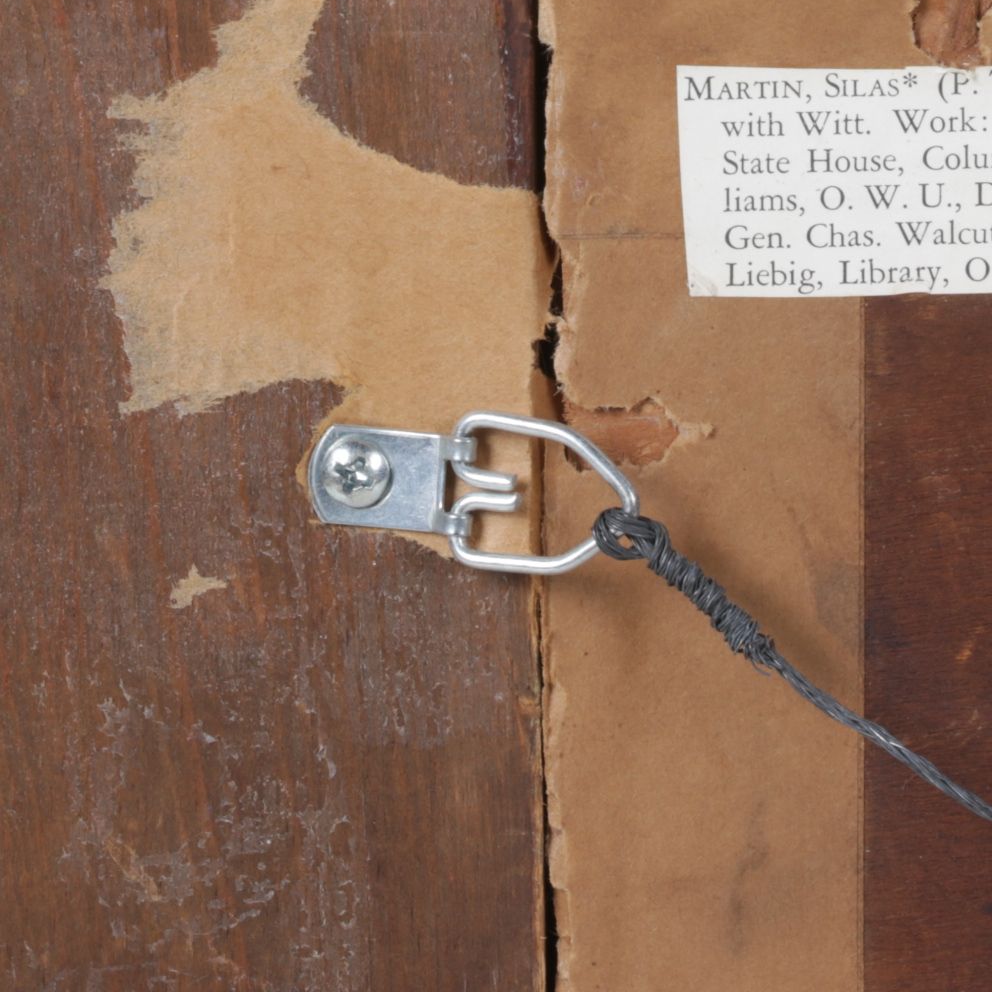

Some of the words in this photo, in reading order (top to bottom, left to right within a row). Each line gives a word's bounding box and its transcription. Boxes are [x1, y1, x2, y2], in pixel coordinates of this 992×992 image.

[684, 75, 812, 103] MARTIN,
[721, 111, 785, 137] with
[796, 110, 871, 136] Witt.
[892, 106, 987, 134] Work:
[722, 150, 790, 175] State
[807, 148, 904, 176] House,
[723, 187, 805, 215] liams,
[819, 185, 853, 211] O.
[864, 184, 908, 209] W.
[918, 182, 962, 213] U.,
[724, 225, 791, 250] Gen.
[806, 223, 881, 249] Chas.
[724, 260, 823, 295] Liebig,
[838, 258, 950, 293] Library,
